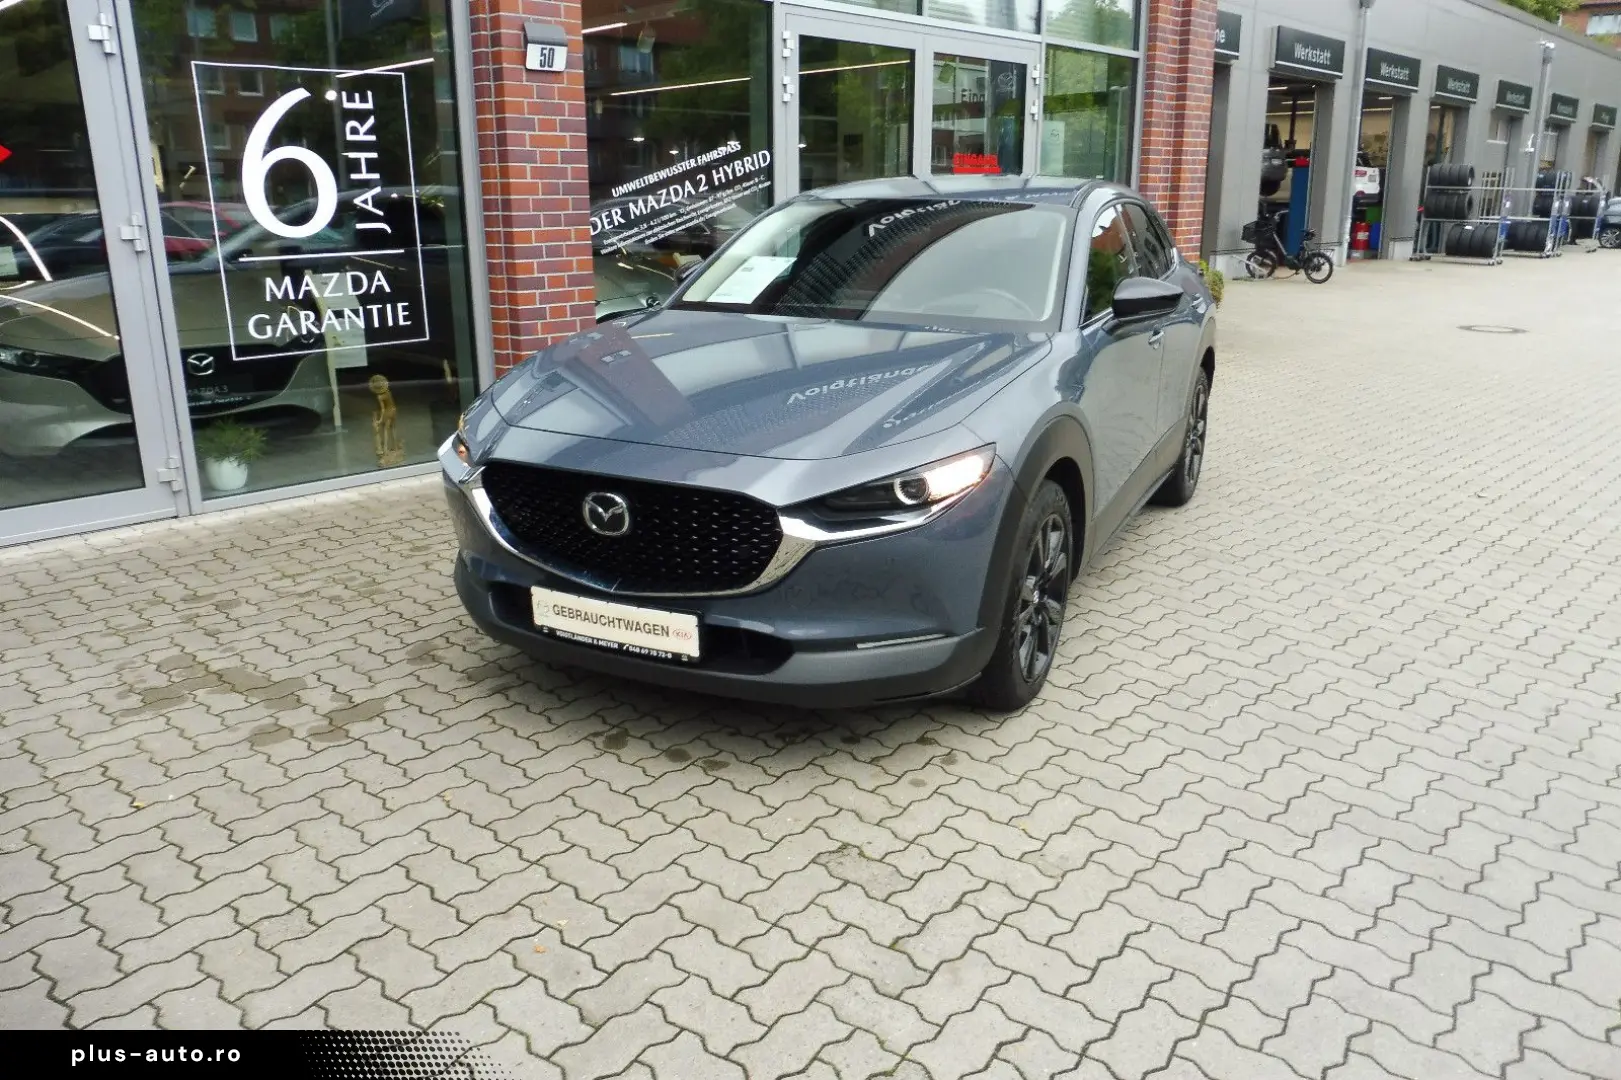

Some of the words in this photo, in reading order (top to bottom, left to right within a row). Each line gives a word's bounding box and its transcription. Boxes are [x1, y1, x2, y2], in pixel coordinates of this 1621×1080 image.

[539, 46, 555, 68] 50
[1294, 43, 1331, 65] Werkstatt
[1380, 62, 1410, 81] Werkstatt
[242, 88, 338, 238] 6
[342, 90, 391, 233] JAHRE
[611, 158, 697, 198] UMWELTBEWUSSTER
[697, 141, 742, 166] FAHRSPASS
[589, 208, 626, 236] DER
[628, 180, 696, 220] MAZDA
[697, 173, 709, 193] 2
[712, 150, 771, 186] HYBRID
[265, 270, 391, 301] MAZDA
[248, 302, 412, 339] GARANTIE
[552, 604, 670, 637] GEBRAUCHTWAGEN
[598, 639, 619, 649] MEYER
